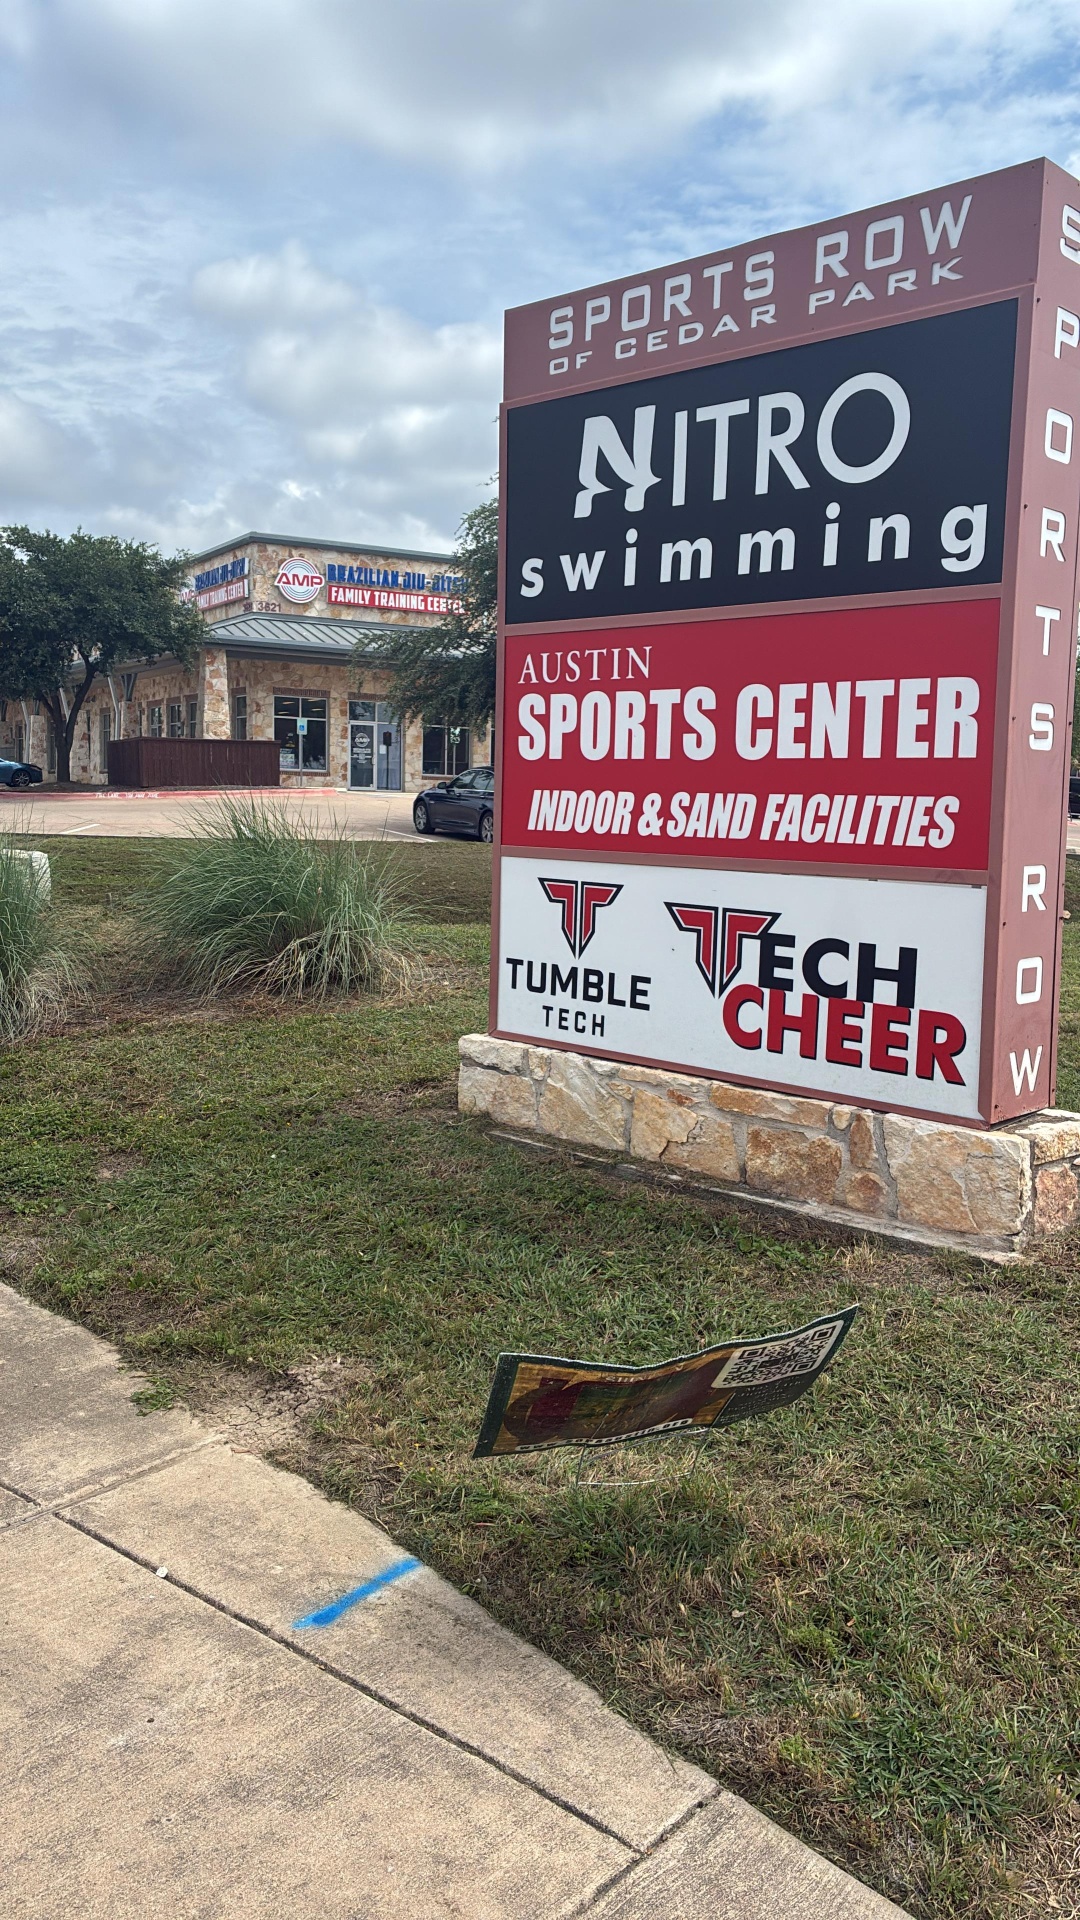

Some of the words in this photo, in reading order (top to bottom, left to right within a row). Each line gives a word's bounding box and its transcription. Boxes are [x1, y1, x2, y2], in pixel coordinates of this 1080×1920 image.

[549, 251, 775, 350] SPORTS
[814, 194, 973, 284] ROW
[549, 351, 593, 375] OF
[614, 303, 777, 360] CEDAR
[808, 256, 964, 315] PARK
[573, 371, 911, 519] NITRO
[327, 563, 399, 588] BRAZILIAN
[520, 501, 988, 598] swimming
[257, 602, 281, 612] 3621
[276, 572, 323, 588] AMP
[331, 586, 371, 605] FAMILY
[373, 591, 425, 610] TRAINING
[517, 645, 653, 685] AUSTIN
[517, 686, 717, 762] SPORTS
[735, 676, 979, 760] CENTER
[528, 789, 637, 834] INDOOR
[759, 793, 960, 849] FACILITIES
[505, 957, 651, 1011] TUMBLE
[1009, 864, 1050, 1096] ROW
[542, 1005, 606, 1038] TECH
[722, 983, 967, 1087] CHEER
